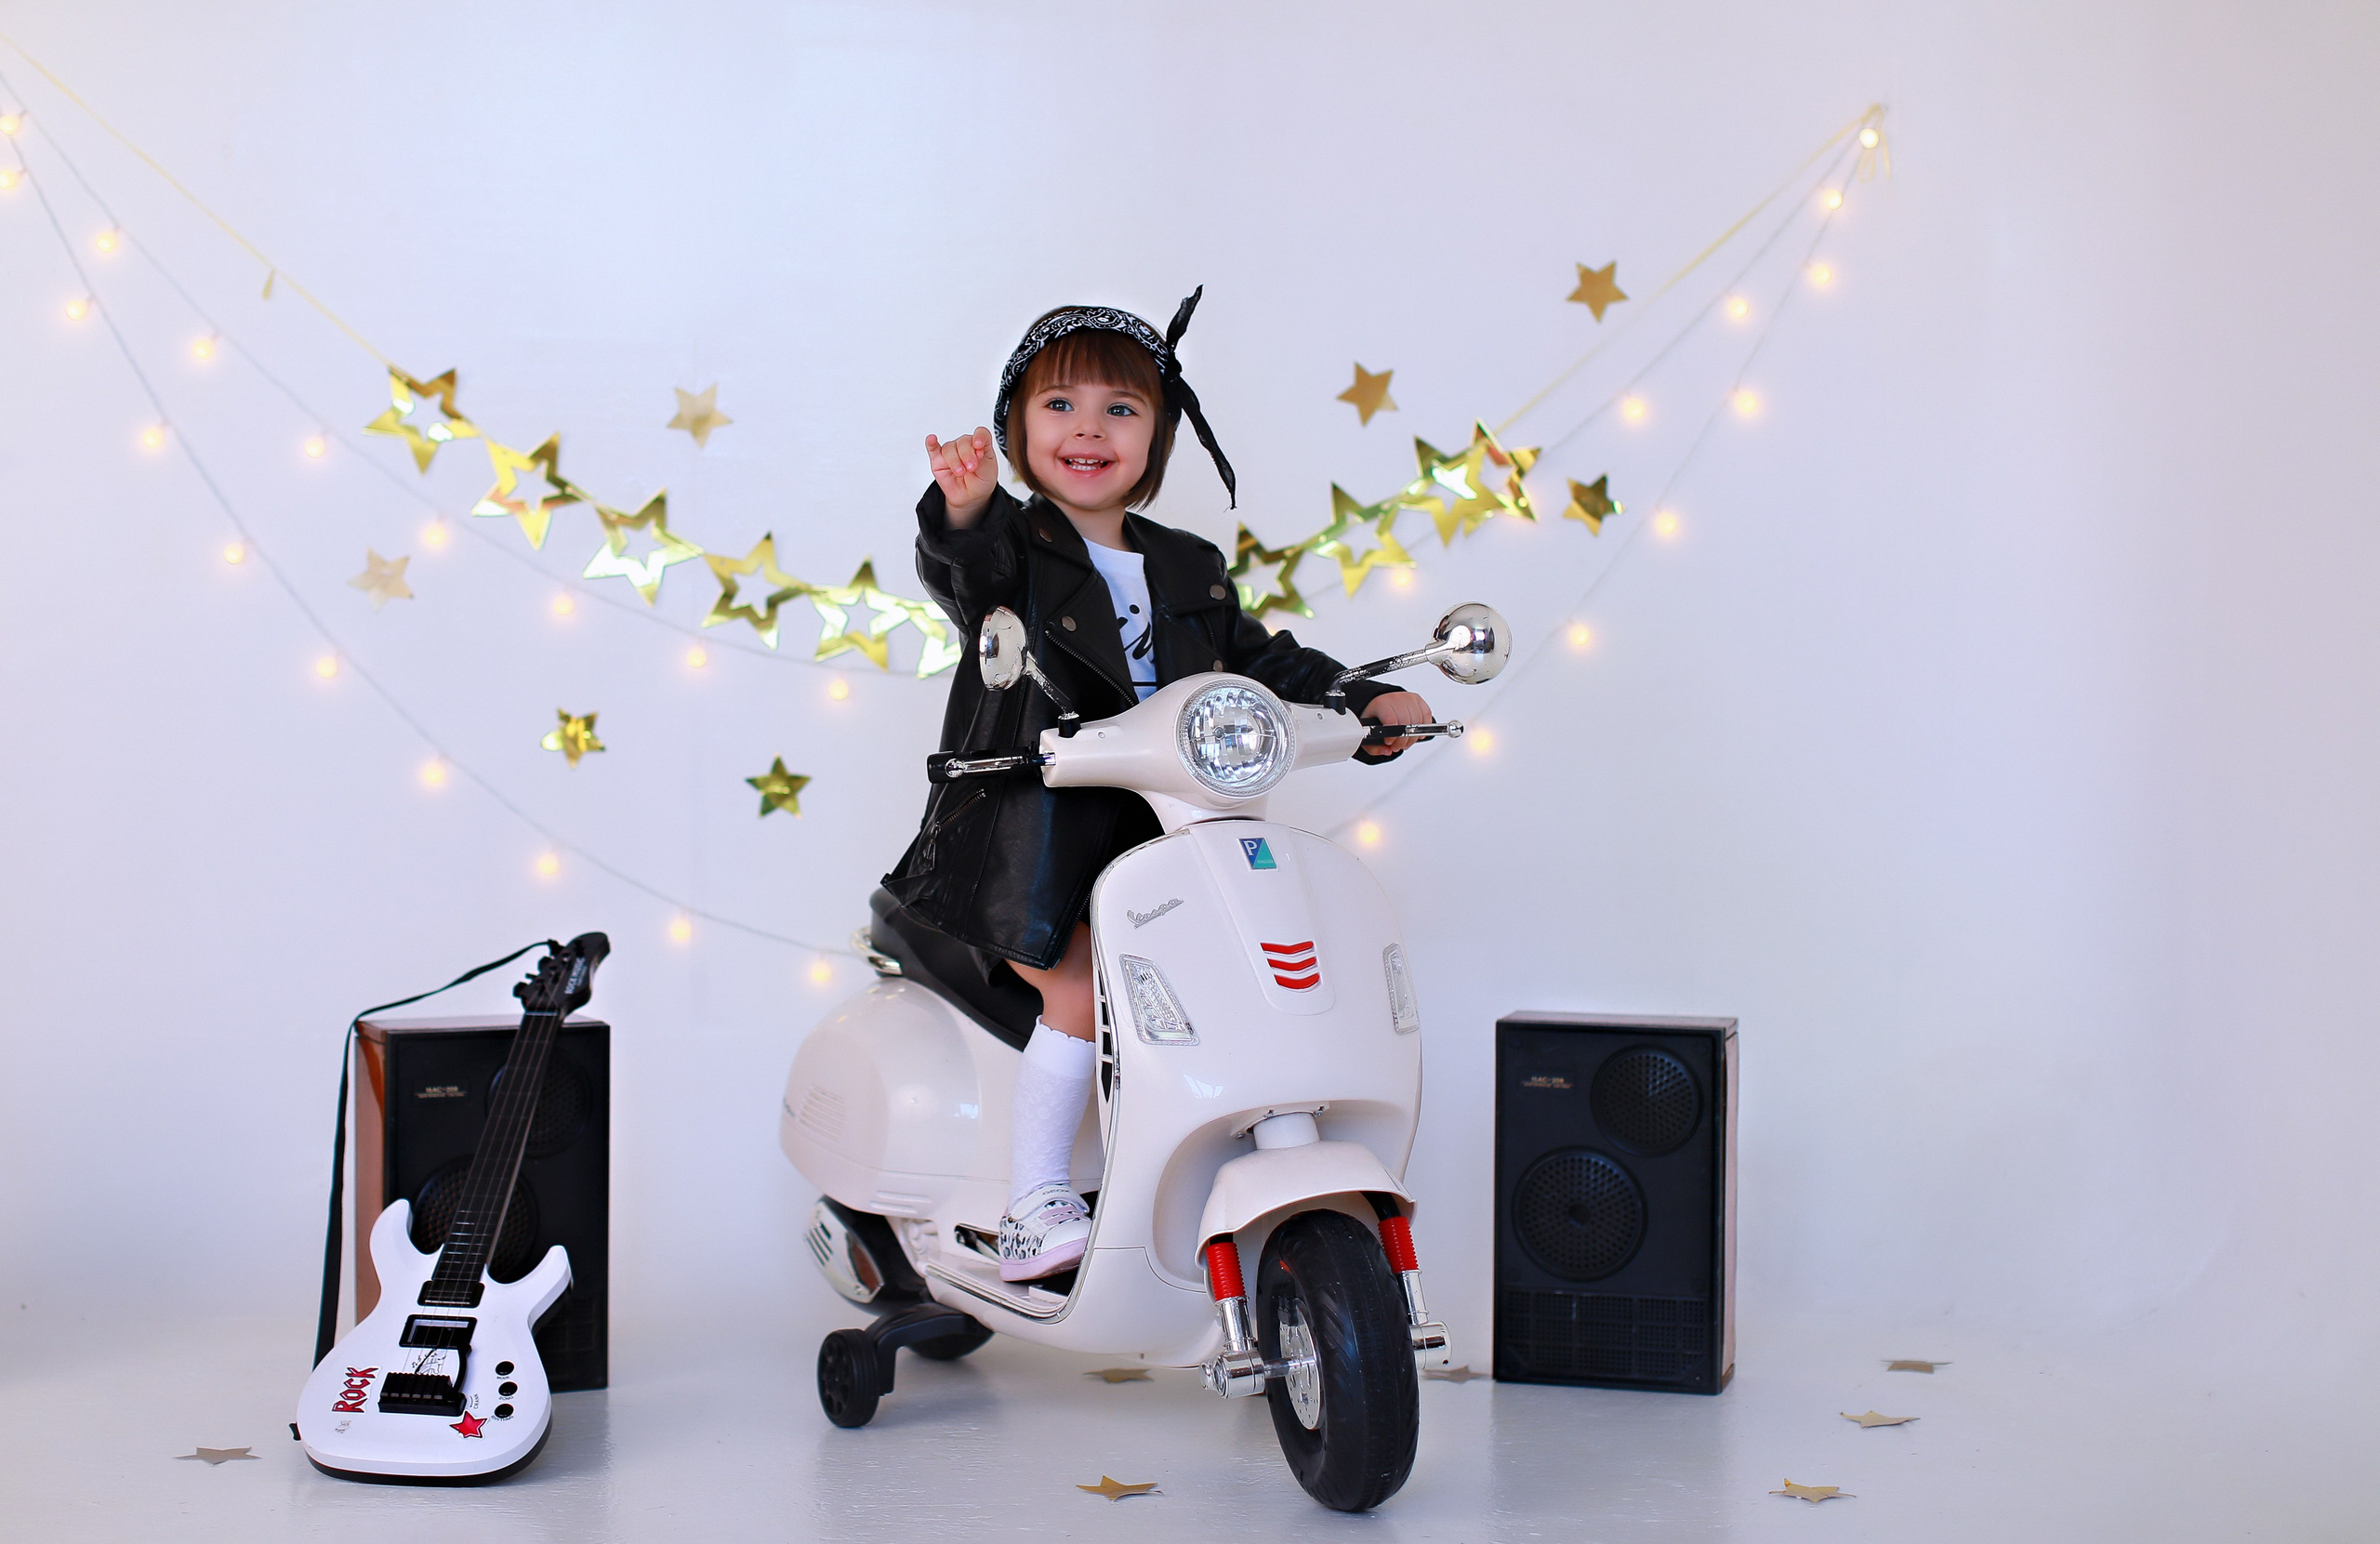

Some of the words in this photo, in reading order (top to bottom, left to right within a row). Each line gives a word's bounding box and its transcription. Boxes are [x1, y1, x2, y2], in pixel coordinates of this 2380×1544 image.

[1243, 840, 1257, 856] P
[1127, 898, 1184, 929] Vespa
[332, 1367, 378, 1413] ROCK
